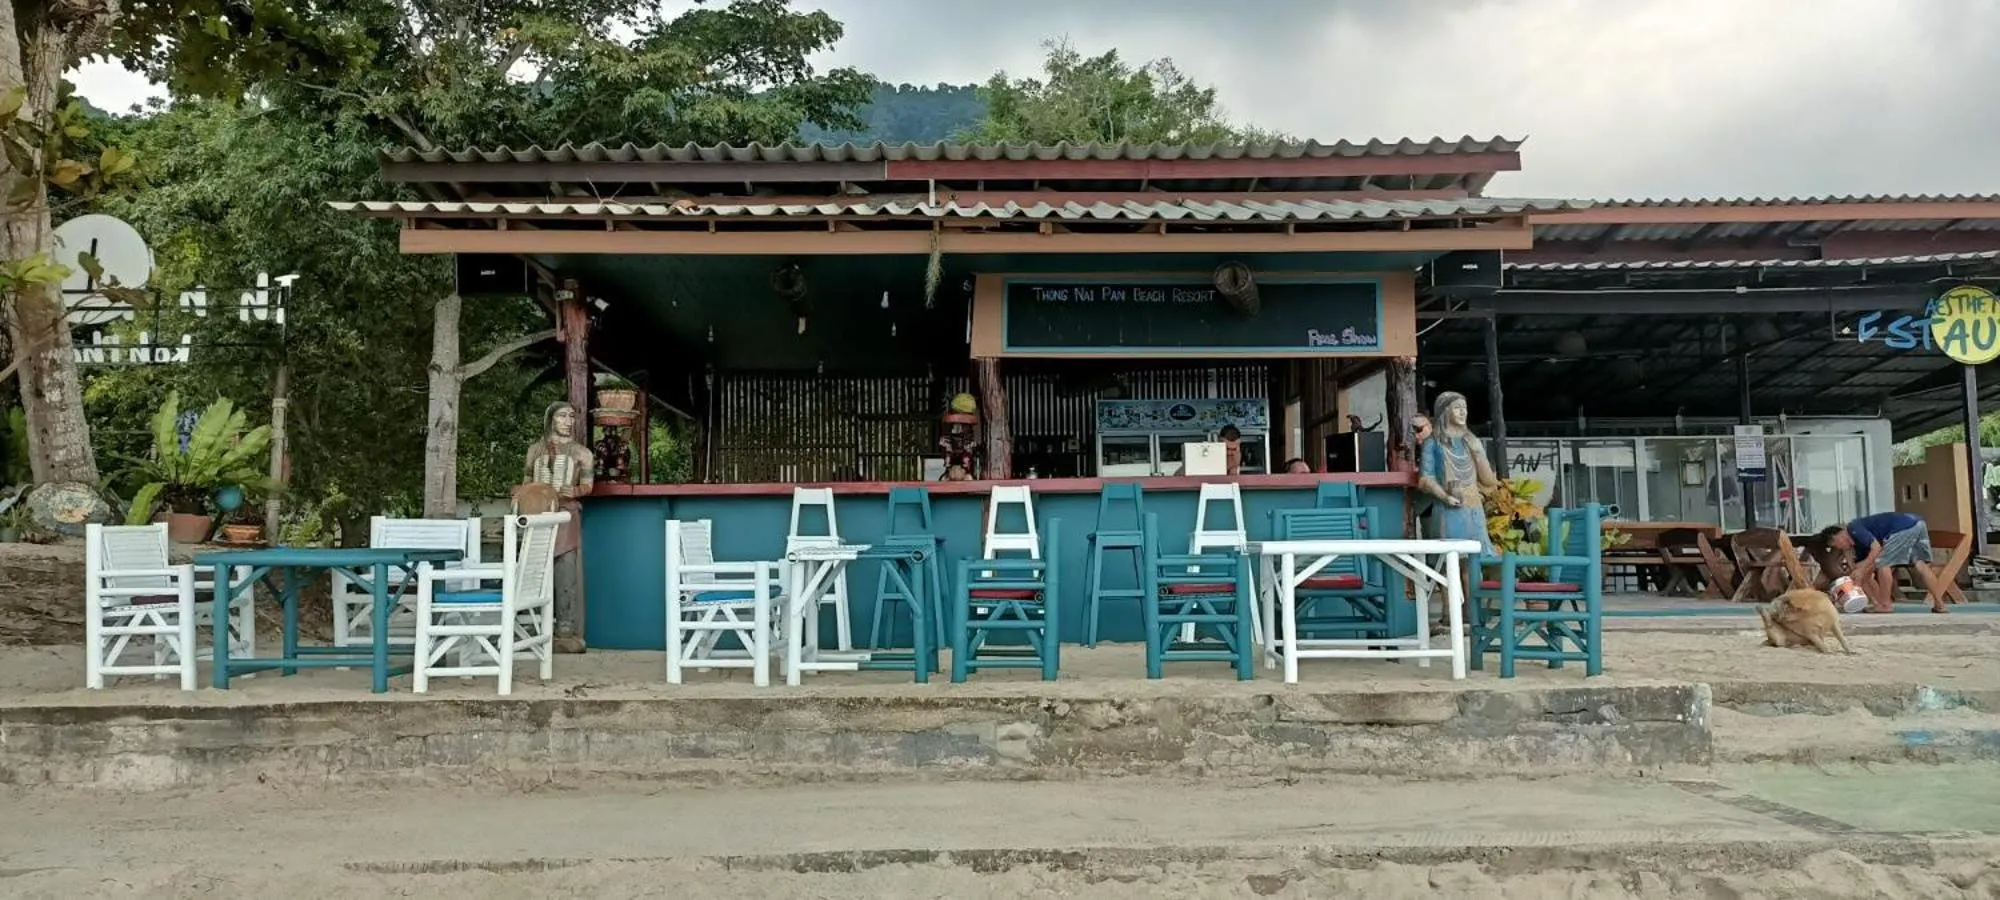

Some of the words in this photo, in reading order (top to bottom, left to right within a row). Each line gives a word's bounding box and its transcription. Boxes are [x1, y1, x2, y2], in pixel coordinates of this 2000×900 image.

[1074, 287, 1095, 301] NAI
[1102, 286, 1126, 301] PAN
[1133, 287, 1166, 302] BEACH
[1172, 287, 1217, 302] RESORT
